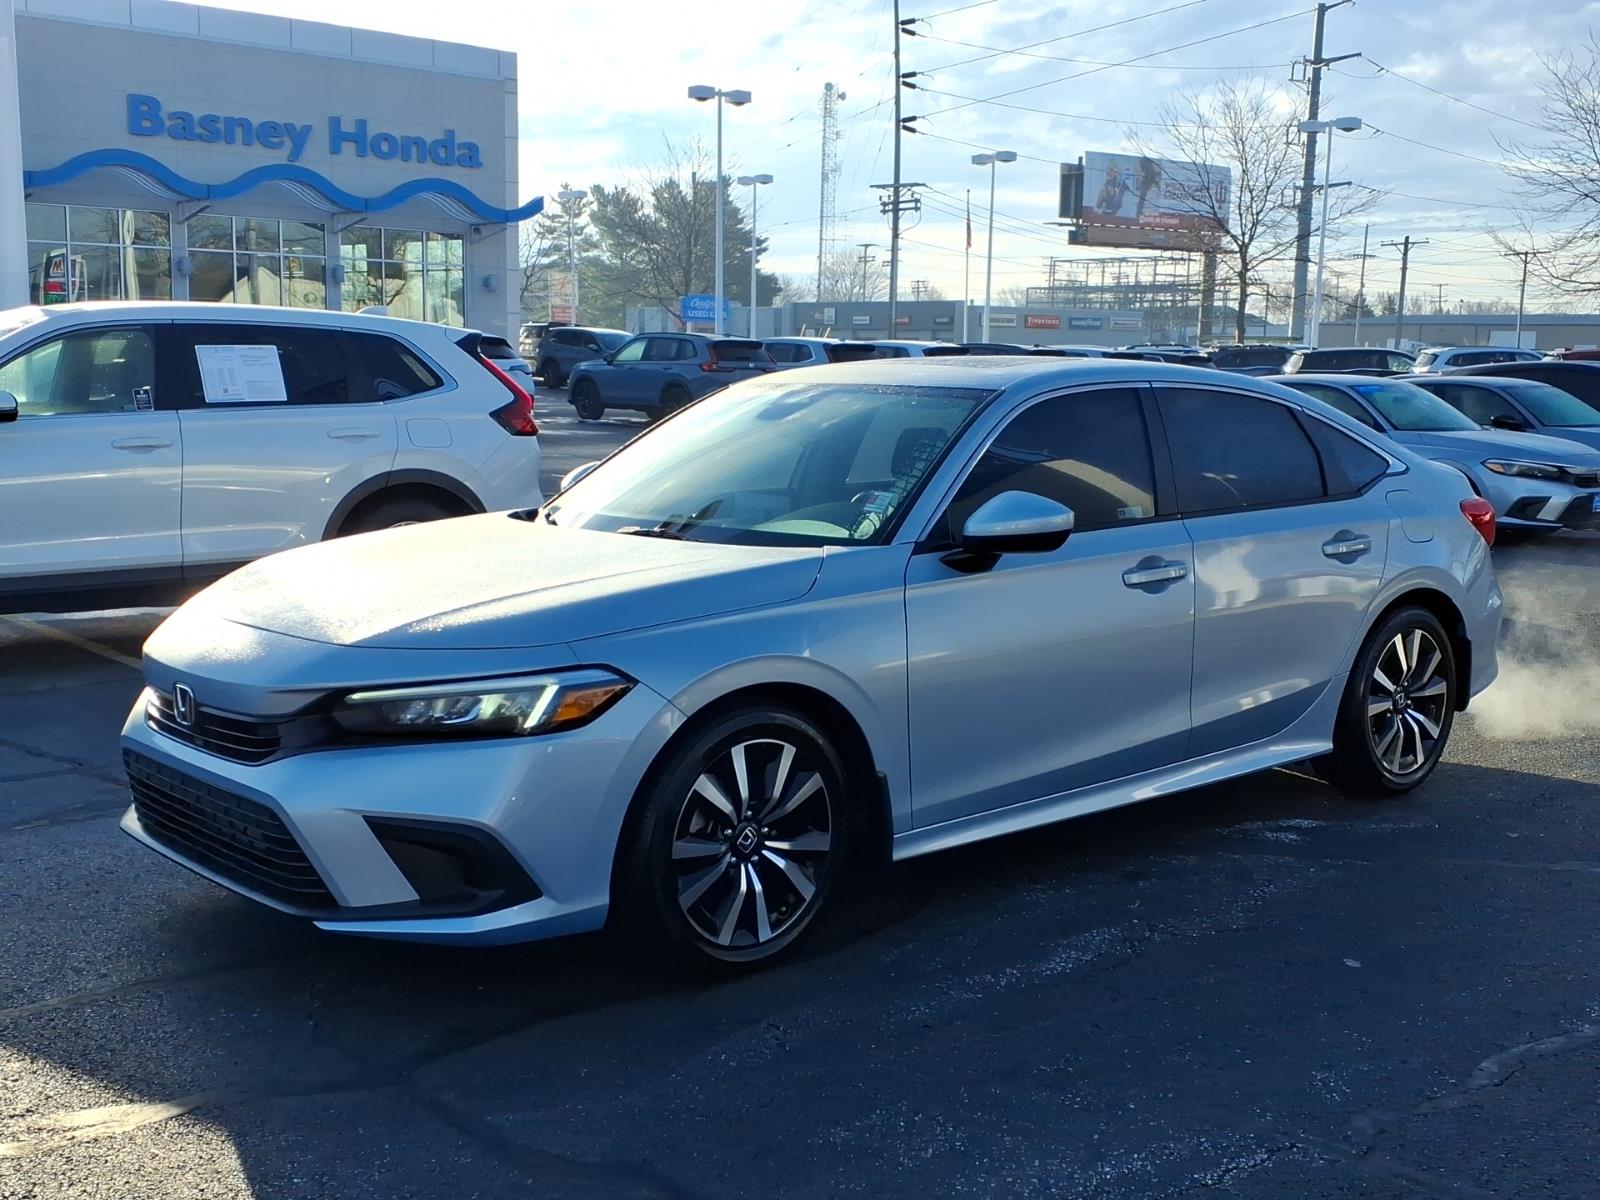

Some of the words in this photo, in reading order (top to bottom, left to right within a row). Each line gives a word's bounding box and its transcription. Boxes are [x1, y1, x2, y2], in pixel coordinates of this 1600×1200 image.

[125, 92, 313, 163] Basney
[328, 114, 483, 170] Honda
[688, 310, 708, 318] USED
